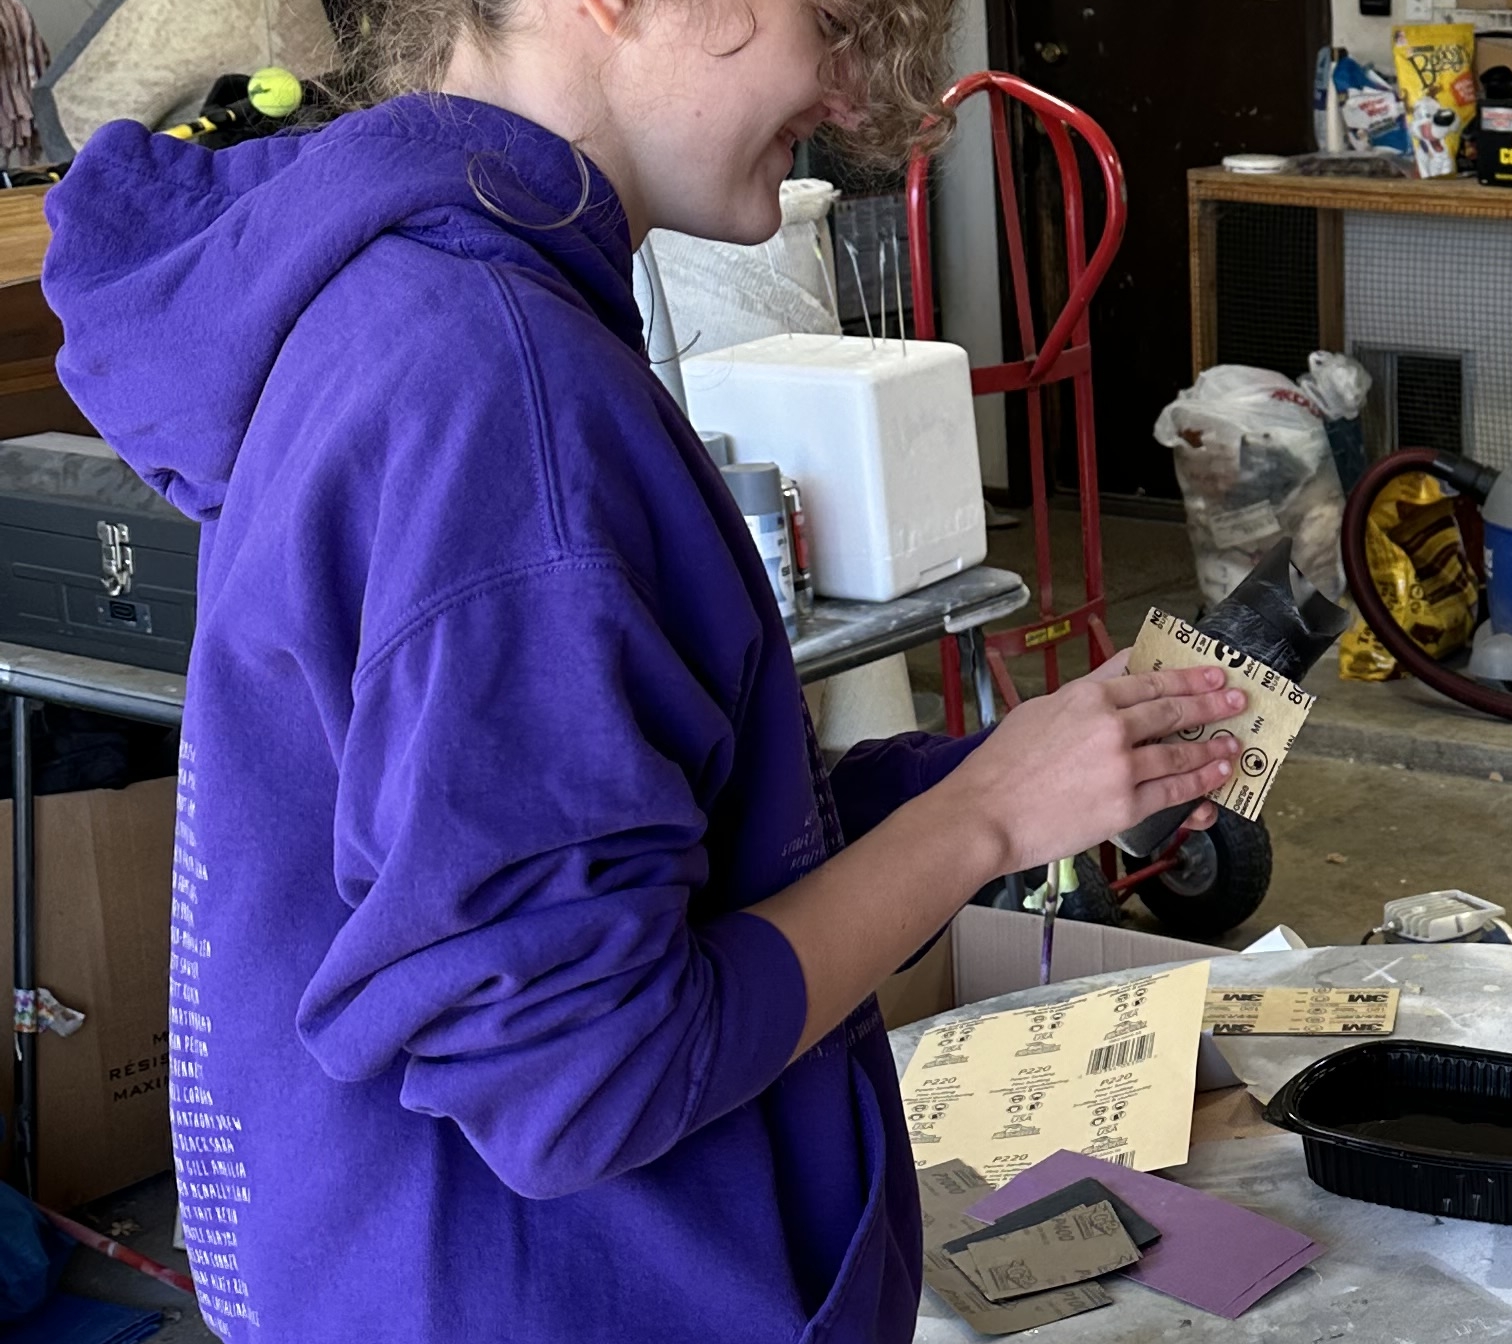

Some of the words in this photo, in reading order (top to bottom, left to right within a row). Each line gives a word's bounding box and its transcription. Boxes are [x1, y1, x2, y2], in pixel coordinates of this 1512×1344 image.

[1251, 716, 1265, 734] MN
[1223, 993, 1264, 1002] 3M
[1348, 994, 1389, 1002] 3M
[1213, 1023, 1255, 1032] 3M
[1342, 1023, 1384, 1032] 3M
[1017, 1065, 1052, 1076] P220
[922, 1076, 957, 1086] P220
[1099, 1072, 1133, 1087] P220
[992, 1153, 1029, 1163] P220
